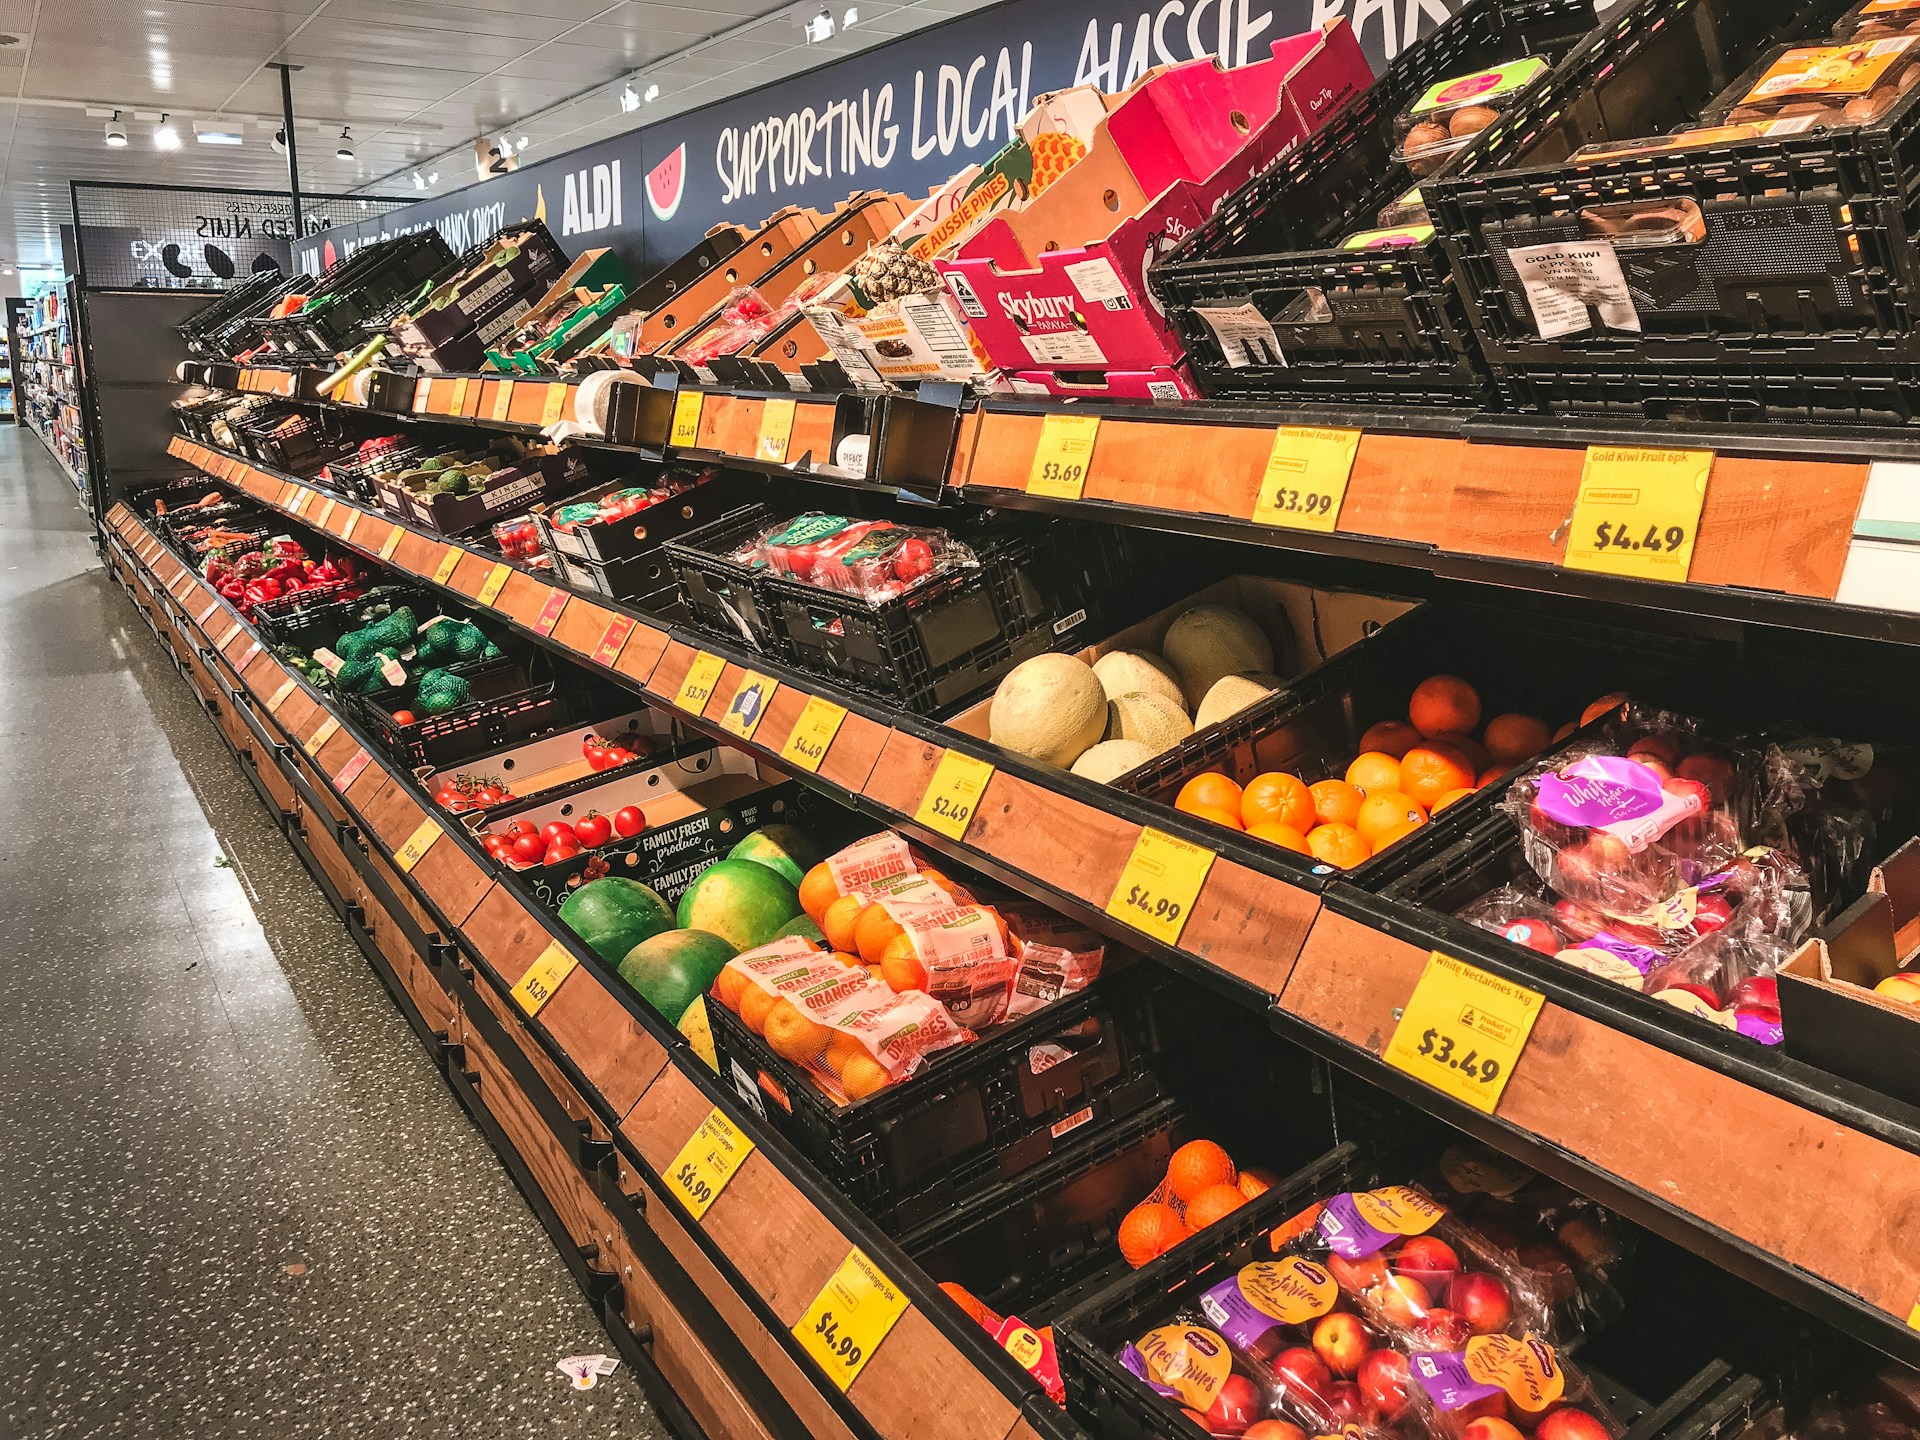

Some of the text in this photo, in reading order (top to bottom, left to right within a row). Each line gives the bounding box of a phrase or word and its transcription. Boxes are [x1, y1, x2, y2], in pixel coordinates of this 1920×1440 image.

[1309, 87, 1333, 111] Our Tip
[715, 82, 899, 204] SUPPORTING
[909, 40, 1033, 161] LOCAL
[488, 147, 508, 173] 2
[562, 159, 622, 237] ALDI
[435, 210, 471, 257] HANDS
[473, 202, 505, 246] DIRTY
[913, 177, 1008, 261] RE AUSSIE PINES
[1525, 250, 1601, 264] GOLD KIWI
[1578, 260, 1593, 268] 16
[466, 283, 490, 303] KING
[469, 289, 496, 311] AVOCADO
[997, 290, 1077, 325] Skybury
[485, 311, 509, 332] KING
[487, 318, 514, 340] AVOCADO
[887, 318, 904, 329] PINES
[1036, 320, 1069, 330] PAPAYA
[1568, 318, 1590, 327] PRODUC
[911, 363, 941, 373] AUSTRALIA
[677, 424, 695, 438] $3.49
[1300, 430, 1316, 439] Kiwi
[1316, 431, 1333, 441] Fruit
[1592, 451, 1689, 464] Gold Kiwi Fruit 6pk
[1042, 461, 1082, 482] $3.69
[491, 482, 520, 498] KING
[491, 489, 525, 506] AVOCADO
[1274, 487, 1332, 516] $3.99
[1594, 520, 1685, 553] $4.49
[685, 684, 708, 701] $3.79
[793, 736, 823, 759] $4.49
[1563, 778, 1607, 808] White
[741, 806, 758, 819] TRUSS
[931, 795, 969, 822] $2.49
[642, 816, 710, 852] FAMILY FRESH
[1146, 829, 1200, 855] Navel Oranges Per
[656, 835, 702, 862] produce
[653, 856, 720, 892] FAMILY FRESH
[842, 860, 906, 888] ORANGES
[881, 872, 907, 887] MARKET
[901, 879, 928, 892] MARKET
[667, 874, 695, 903] prod
[1126, 884, 1181, 923] $4.99
[772, 970, 800, 985] MARKET
[1436, 956, 1532, 1007] White Nectarines 1kg
[525, 977, 548, 1002] $1.29
[800, 983, 828, 998] MARKET
[805, 977, 869, 1009] ORANGES
[1478, 1023, 1507, 1041] Australia
[1480, 1014, 1513, 1034] Product of
[886, 1014, 948, 1061] ORANGES
[1417, 1027, 1500, 1084] $3.49
[711, 1113, 733, 1137] MARKET BUY
[718, 1134, 735, 1153] Oranges
[676, 1162, 712, 1204] $6.99
[851, 1252, 896, 1303] Navel Oranges 5pk
[1255, 1264, 1324, 1309] Nectarines
[815, 1311, 863, 1367] $4.99
[1014, 1338, 1037, 1359] Navel
[1233, 1330, 1248, 1349] 1kg
[1033, 1369, 1042, 1378] 5
[1143, 1333, 1219, 1393] Nectarines
